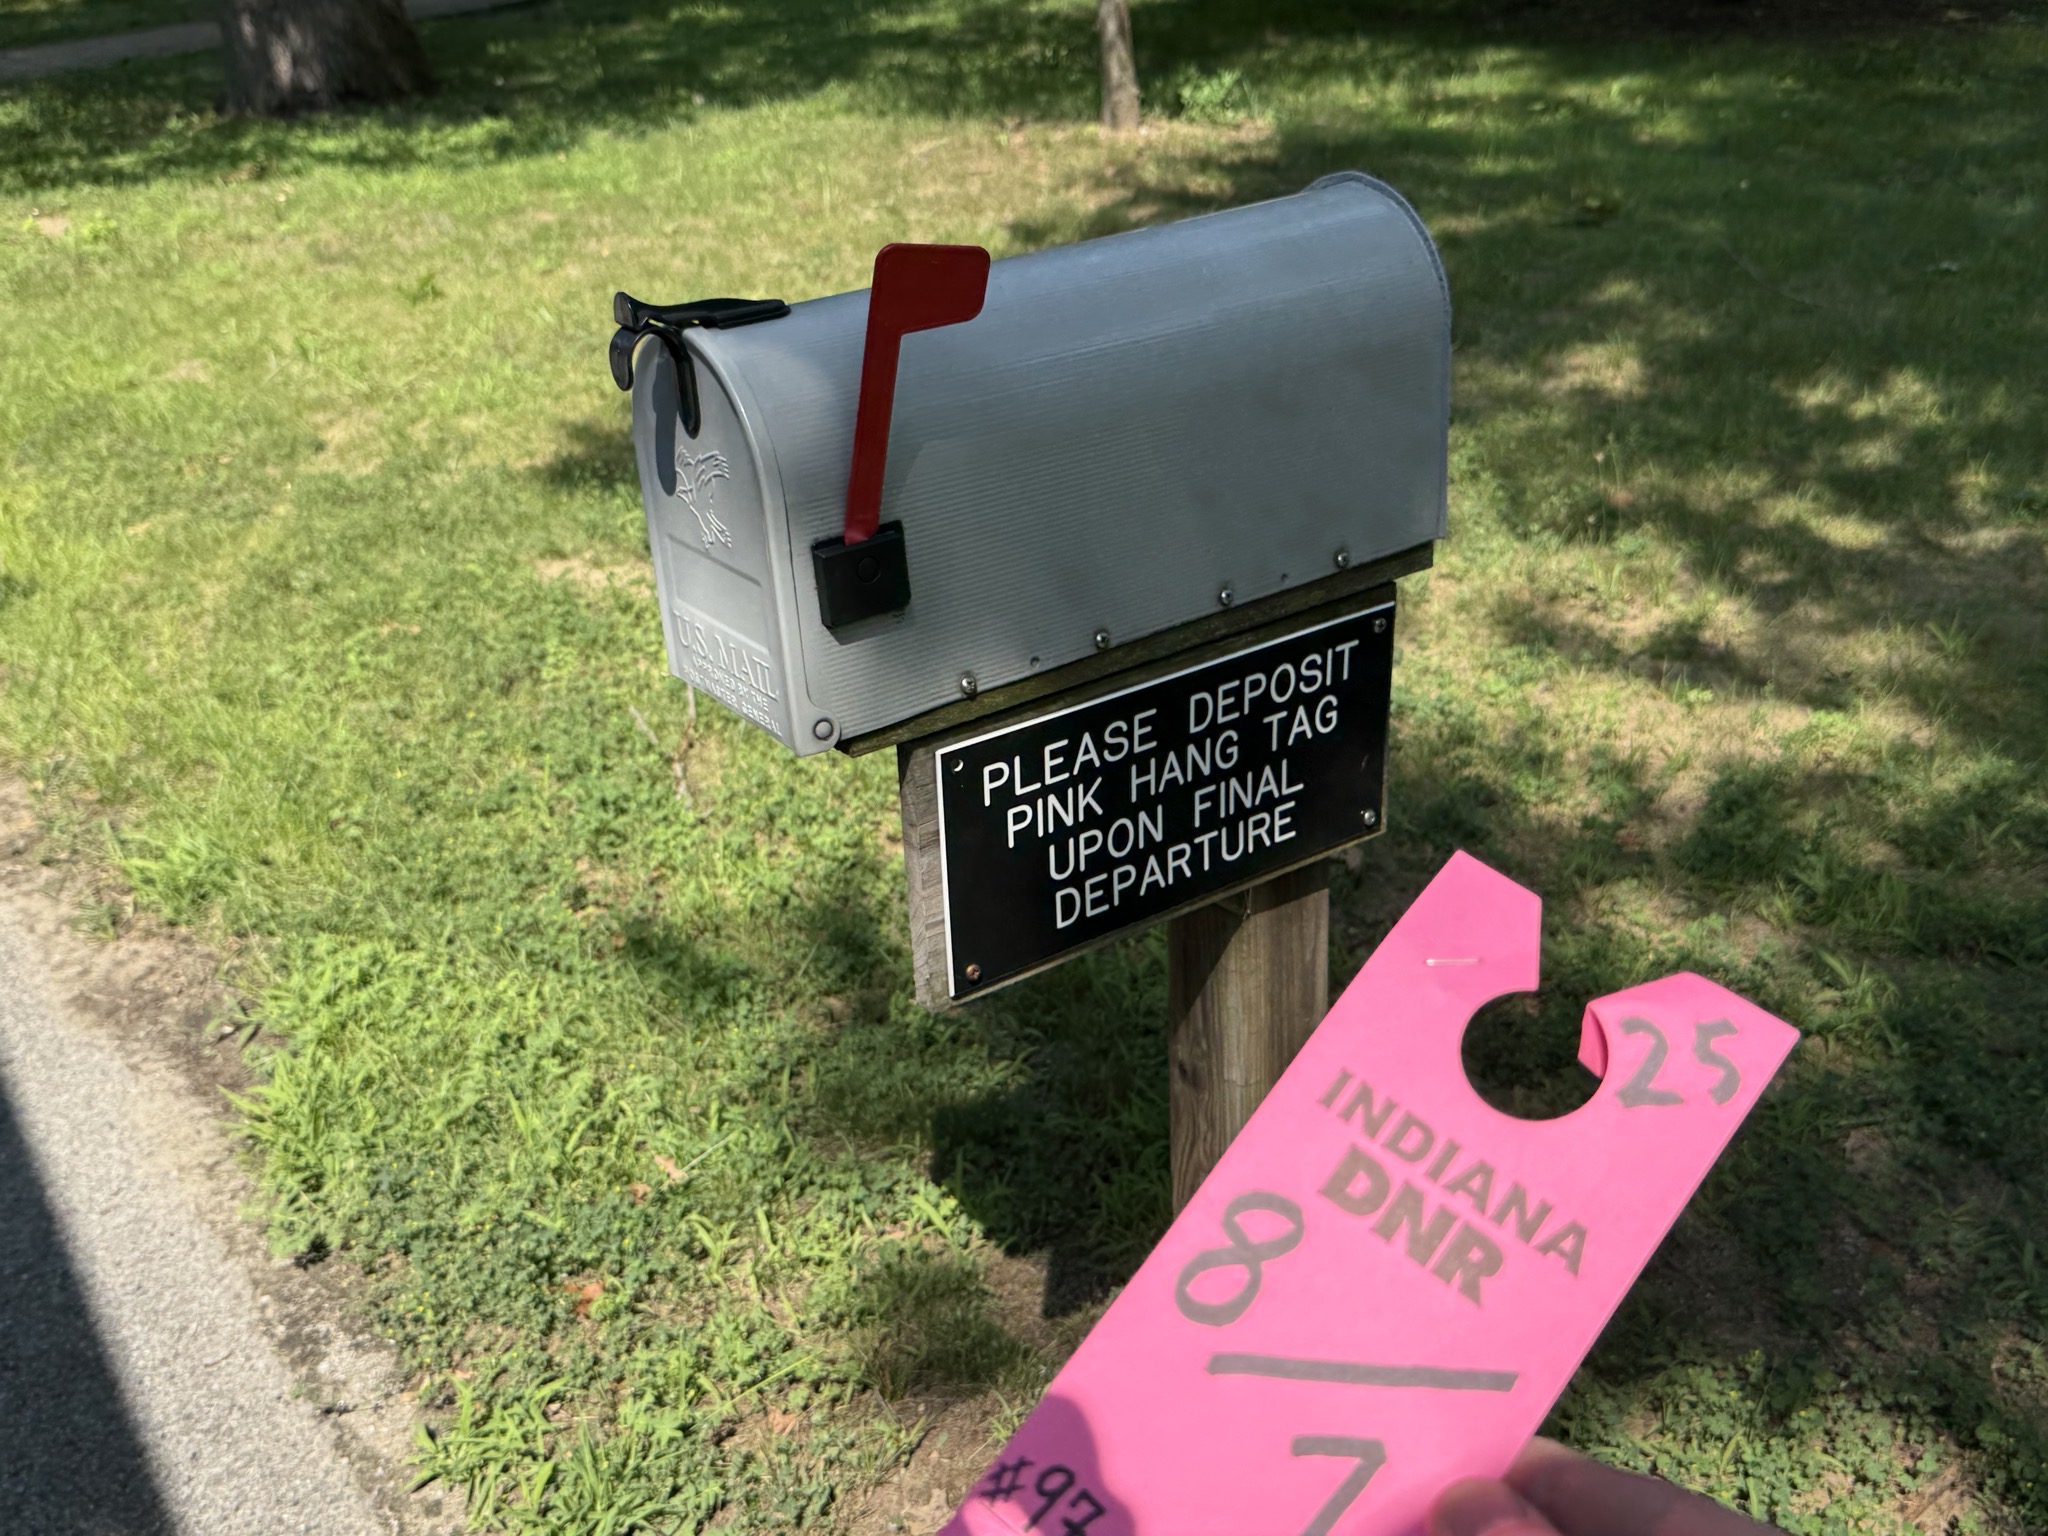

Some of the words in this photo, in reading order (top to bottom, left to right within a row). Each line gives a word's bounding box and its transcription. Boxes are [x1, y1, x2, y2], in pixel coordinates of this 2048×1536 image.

[714, 634, 780, 702] MAIL
[982, 708, 1158, 807] PLEASE
[1188, 639, 1360, 734] DEPOSIT
[1006, 776, 1104, 849] PINK
[1130, 730, 1239, 803] HANG
[1263, 694, 1339, 753] TAG
[1048, 804, 1163, 881] UPON
[1193, 758, 1305, 828] FINAL
[1055, 800, 1298, 930] DEPARTURE
[1613, 1016, 1742, 1108] 25
[1316, 1142, 1505, 1308] DNR
[1318, 1066, 1589, 1278] INDIANA
